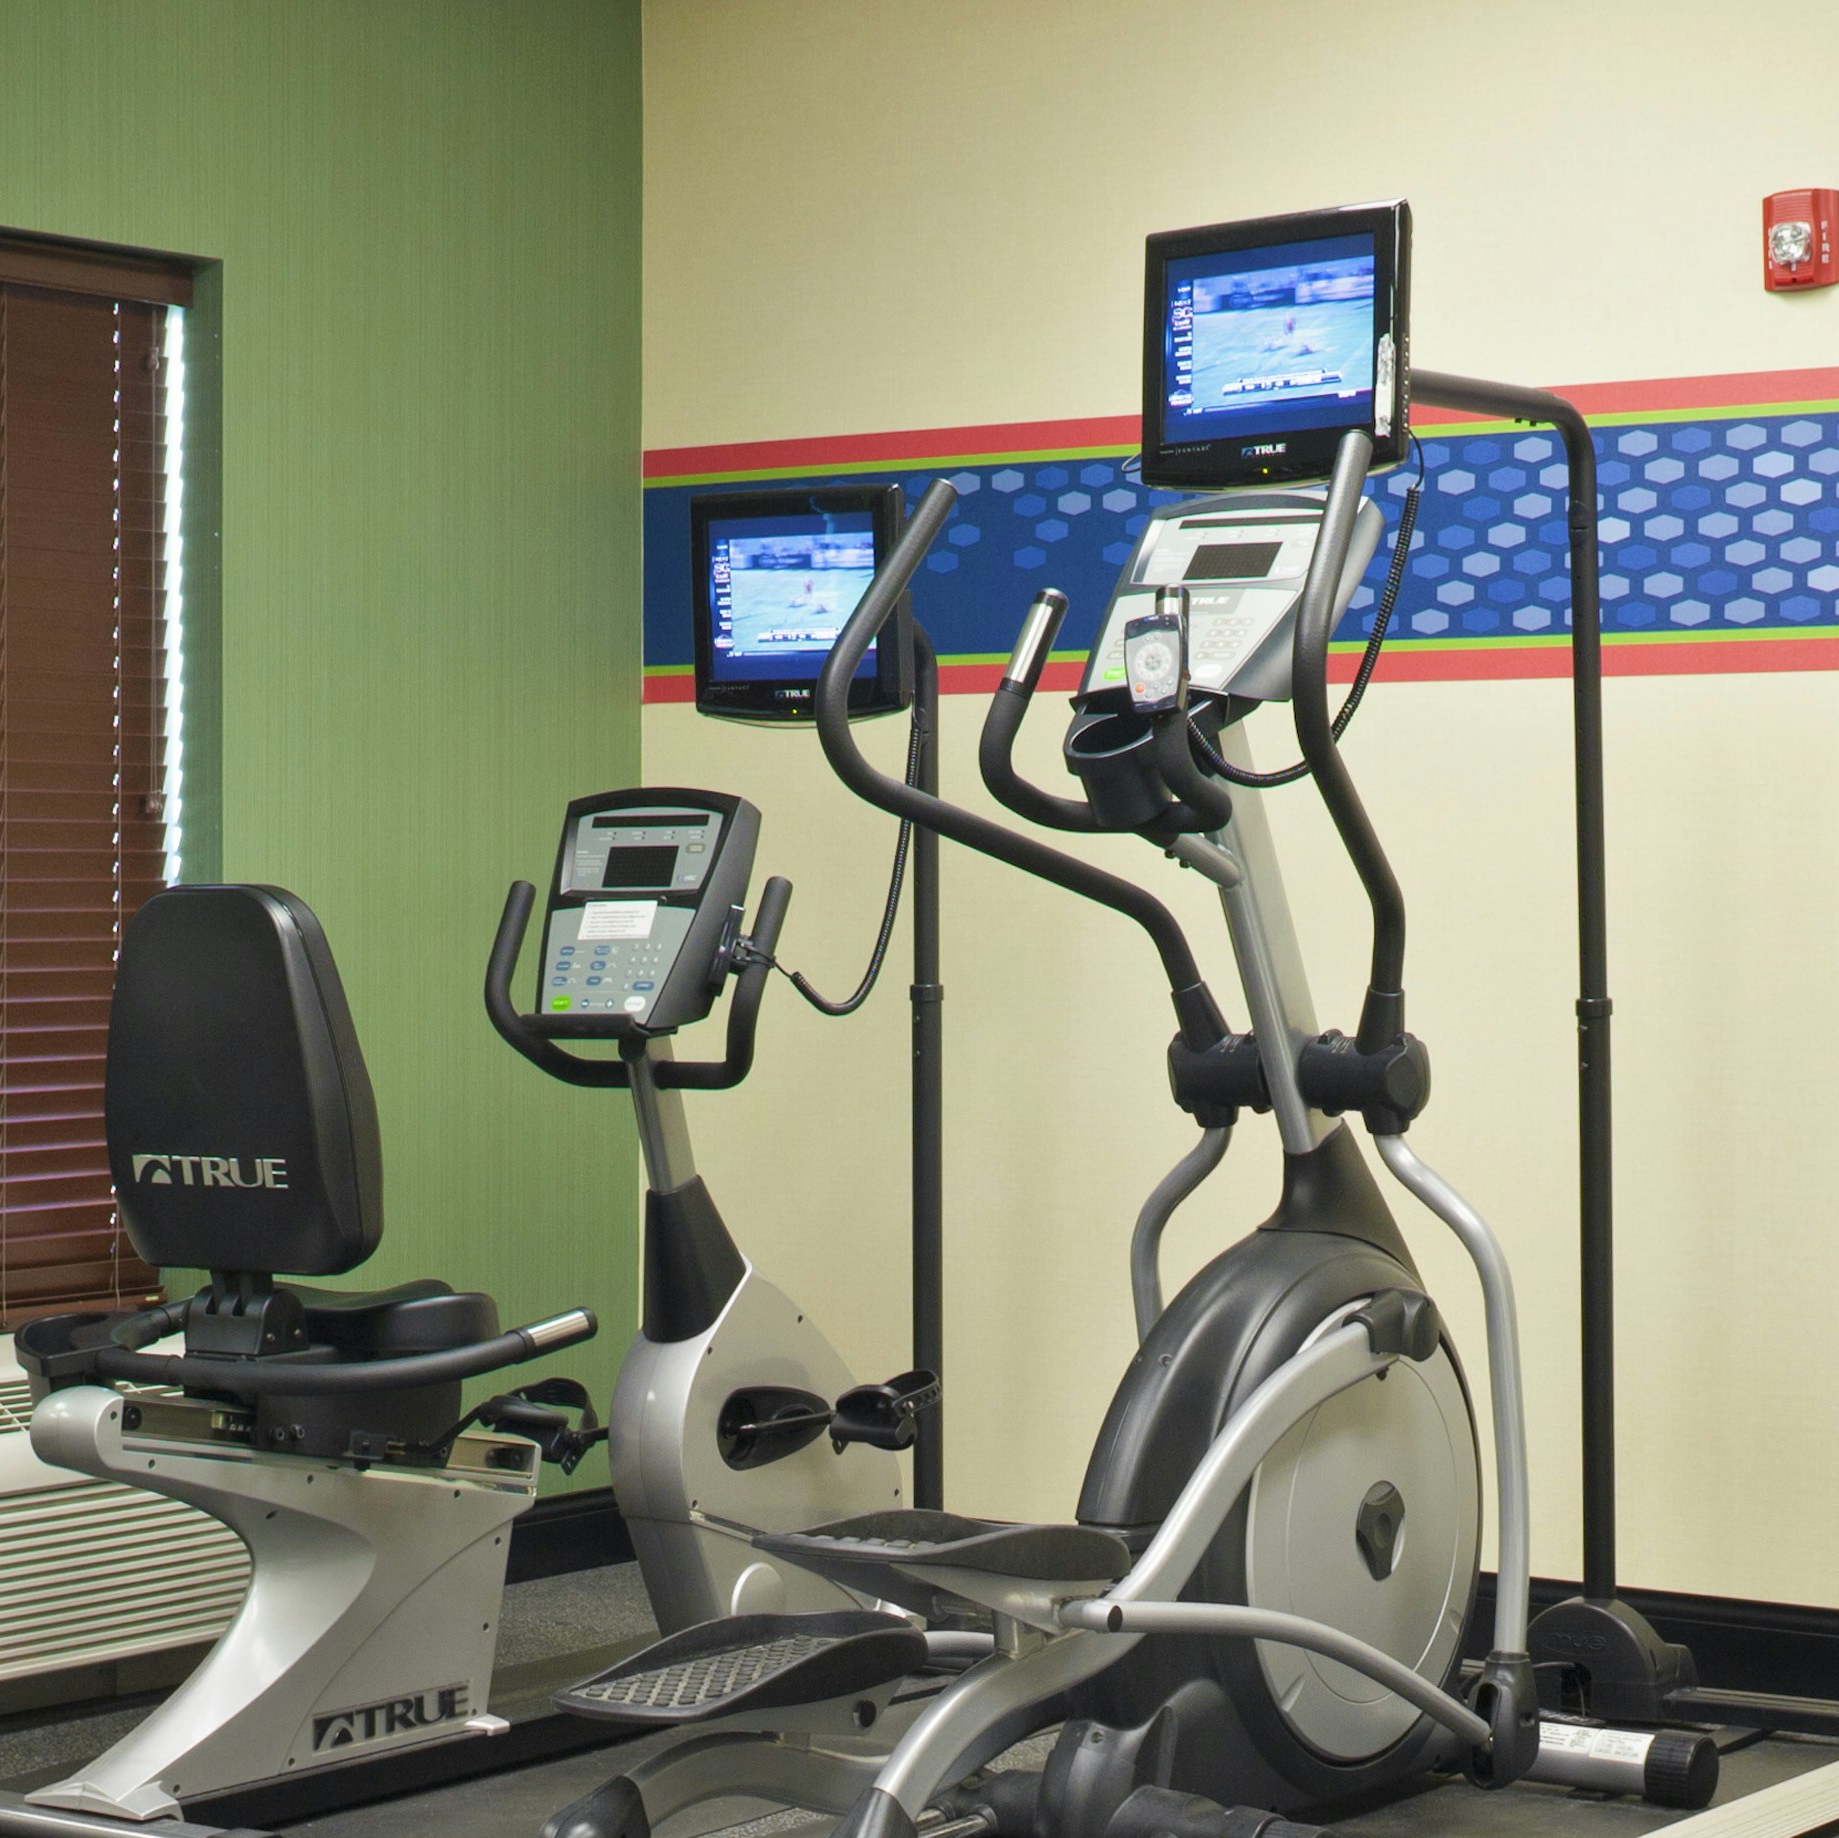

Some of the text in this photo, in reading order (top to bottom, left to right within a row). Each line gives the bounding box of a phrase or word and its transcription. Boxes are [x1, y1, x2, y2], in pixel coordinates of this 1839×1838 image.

[1820, 219, 1831, 264] FIRE
[1253, 442, 1286, 456] TRUE
[1191, 596, 1231, 606] TRUE
[783, 688, 811, 699] TRUE
[171, 1154, 289, 1190] TRUE
[355, 1682, 470, 1739] TRUE
